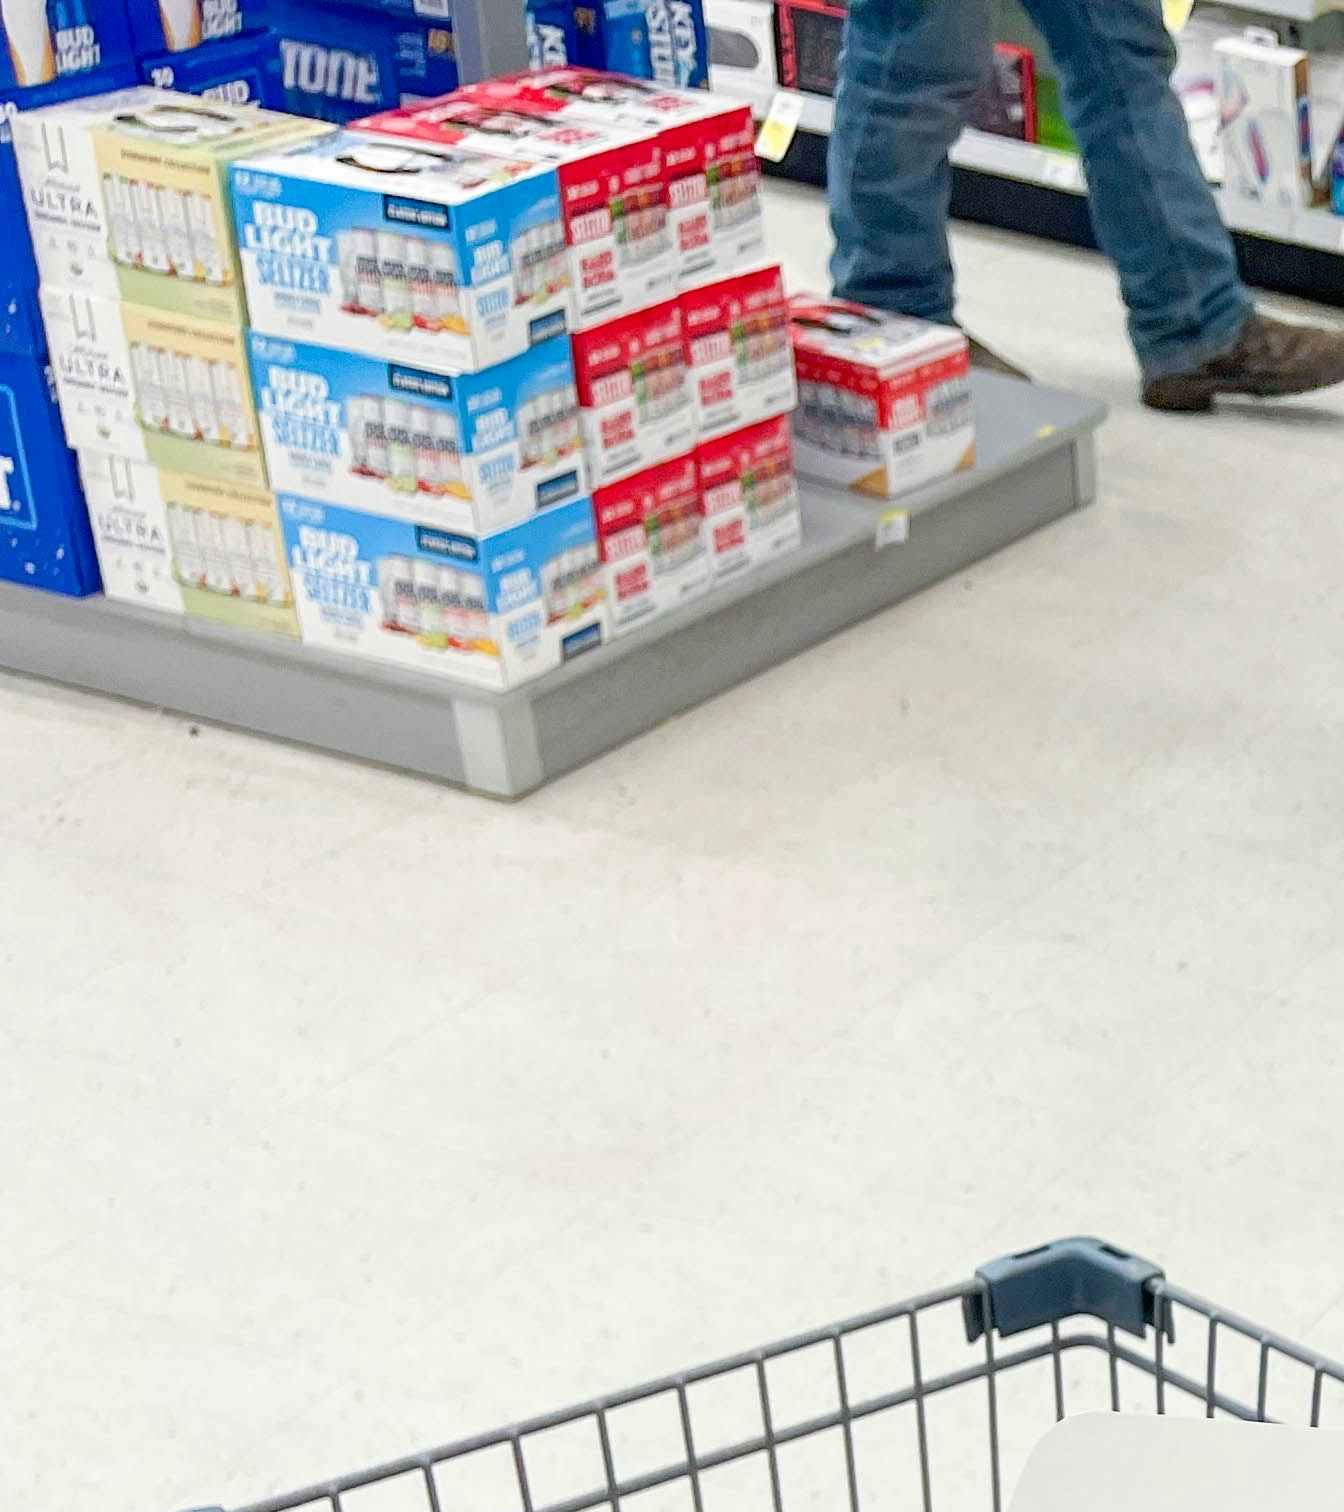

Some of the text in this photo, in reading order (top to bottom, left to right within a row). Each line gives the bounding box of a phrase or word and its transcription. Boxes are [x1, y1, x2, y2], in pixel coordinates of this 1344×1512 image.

[31, 189, 99, 217] ULTRA
[252, 201, 318, 235] BUD
[244, 222, 334, 262] LIGHT
[268, 366, 330, 402] BUD
[261, 387, 342, 428] LIGHT
[298, 524, 359, 560] BUD
[292, 545, 371, 588] LIGHT
